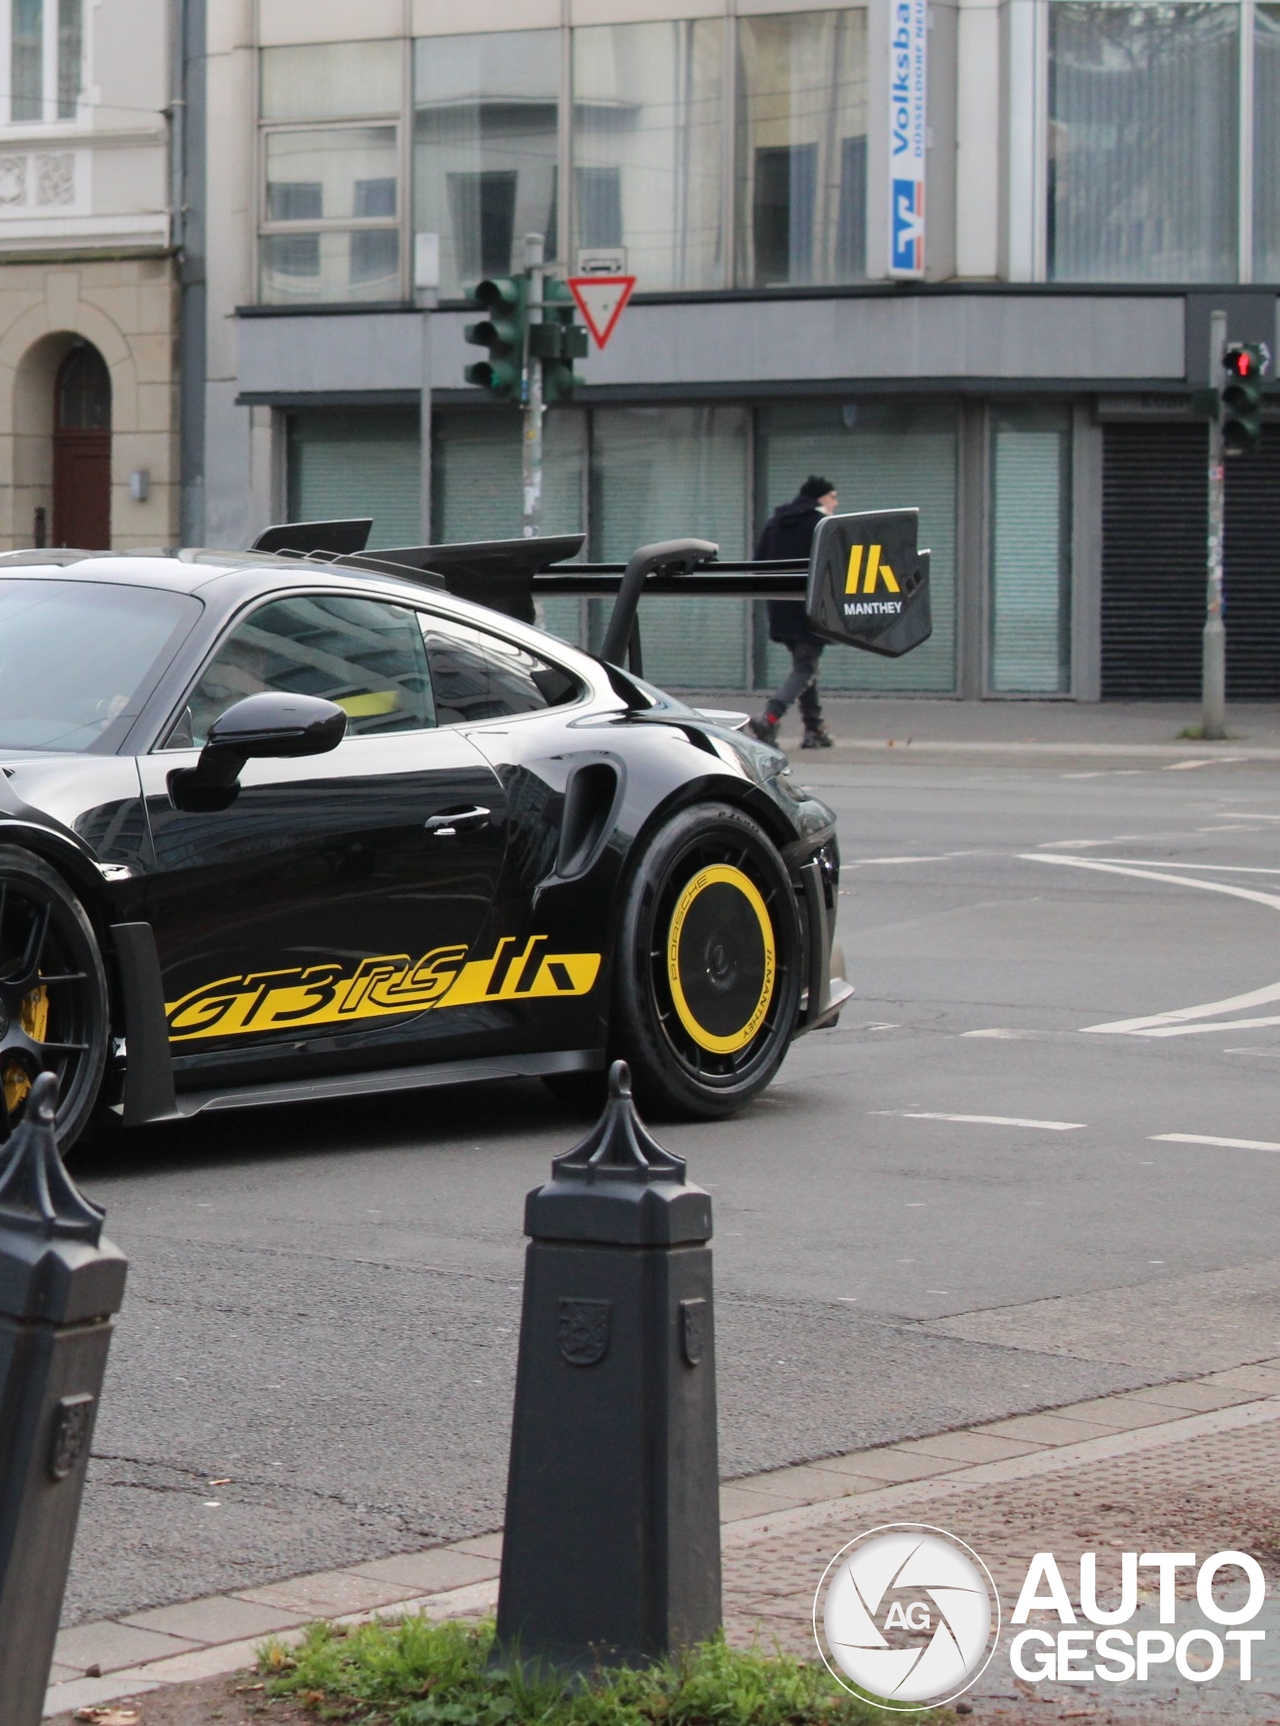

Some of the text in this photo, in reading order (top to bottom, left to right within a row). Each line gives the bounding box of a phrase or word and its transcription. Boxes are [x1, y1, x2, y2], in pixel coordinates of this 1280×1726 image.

[892, 3, 910, 157] Volksba
[843, 601, 902, 616] MANTHEY
[670, 874, 708, 981] PORSCHE
